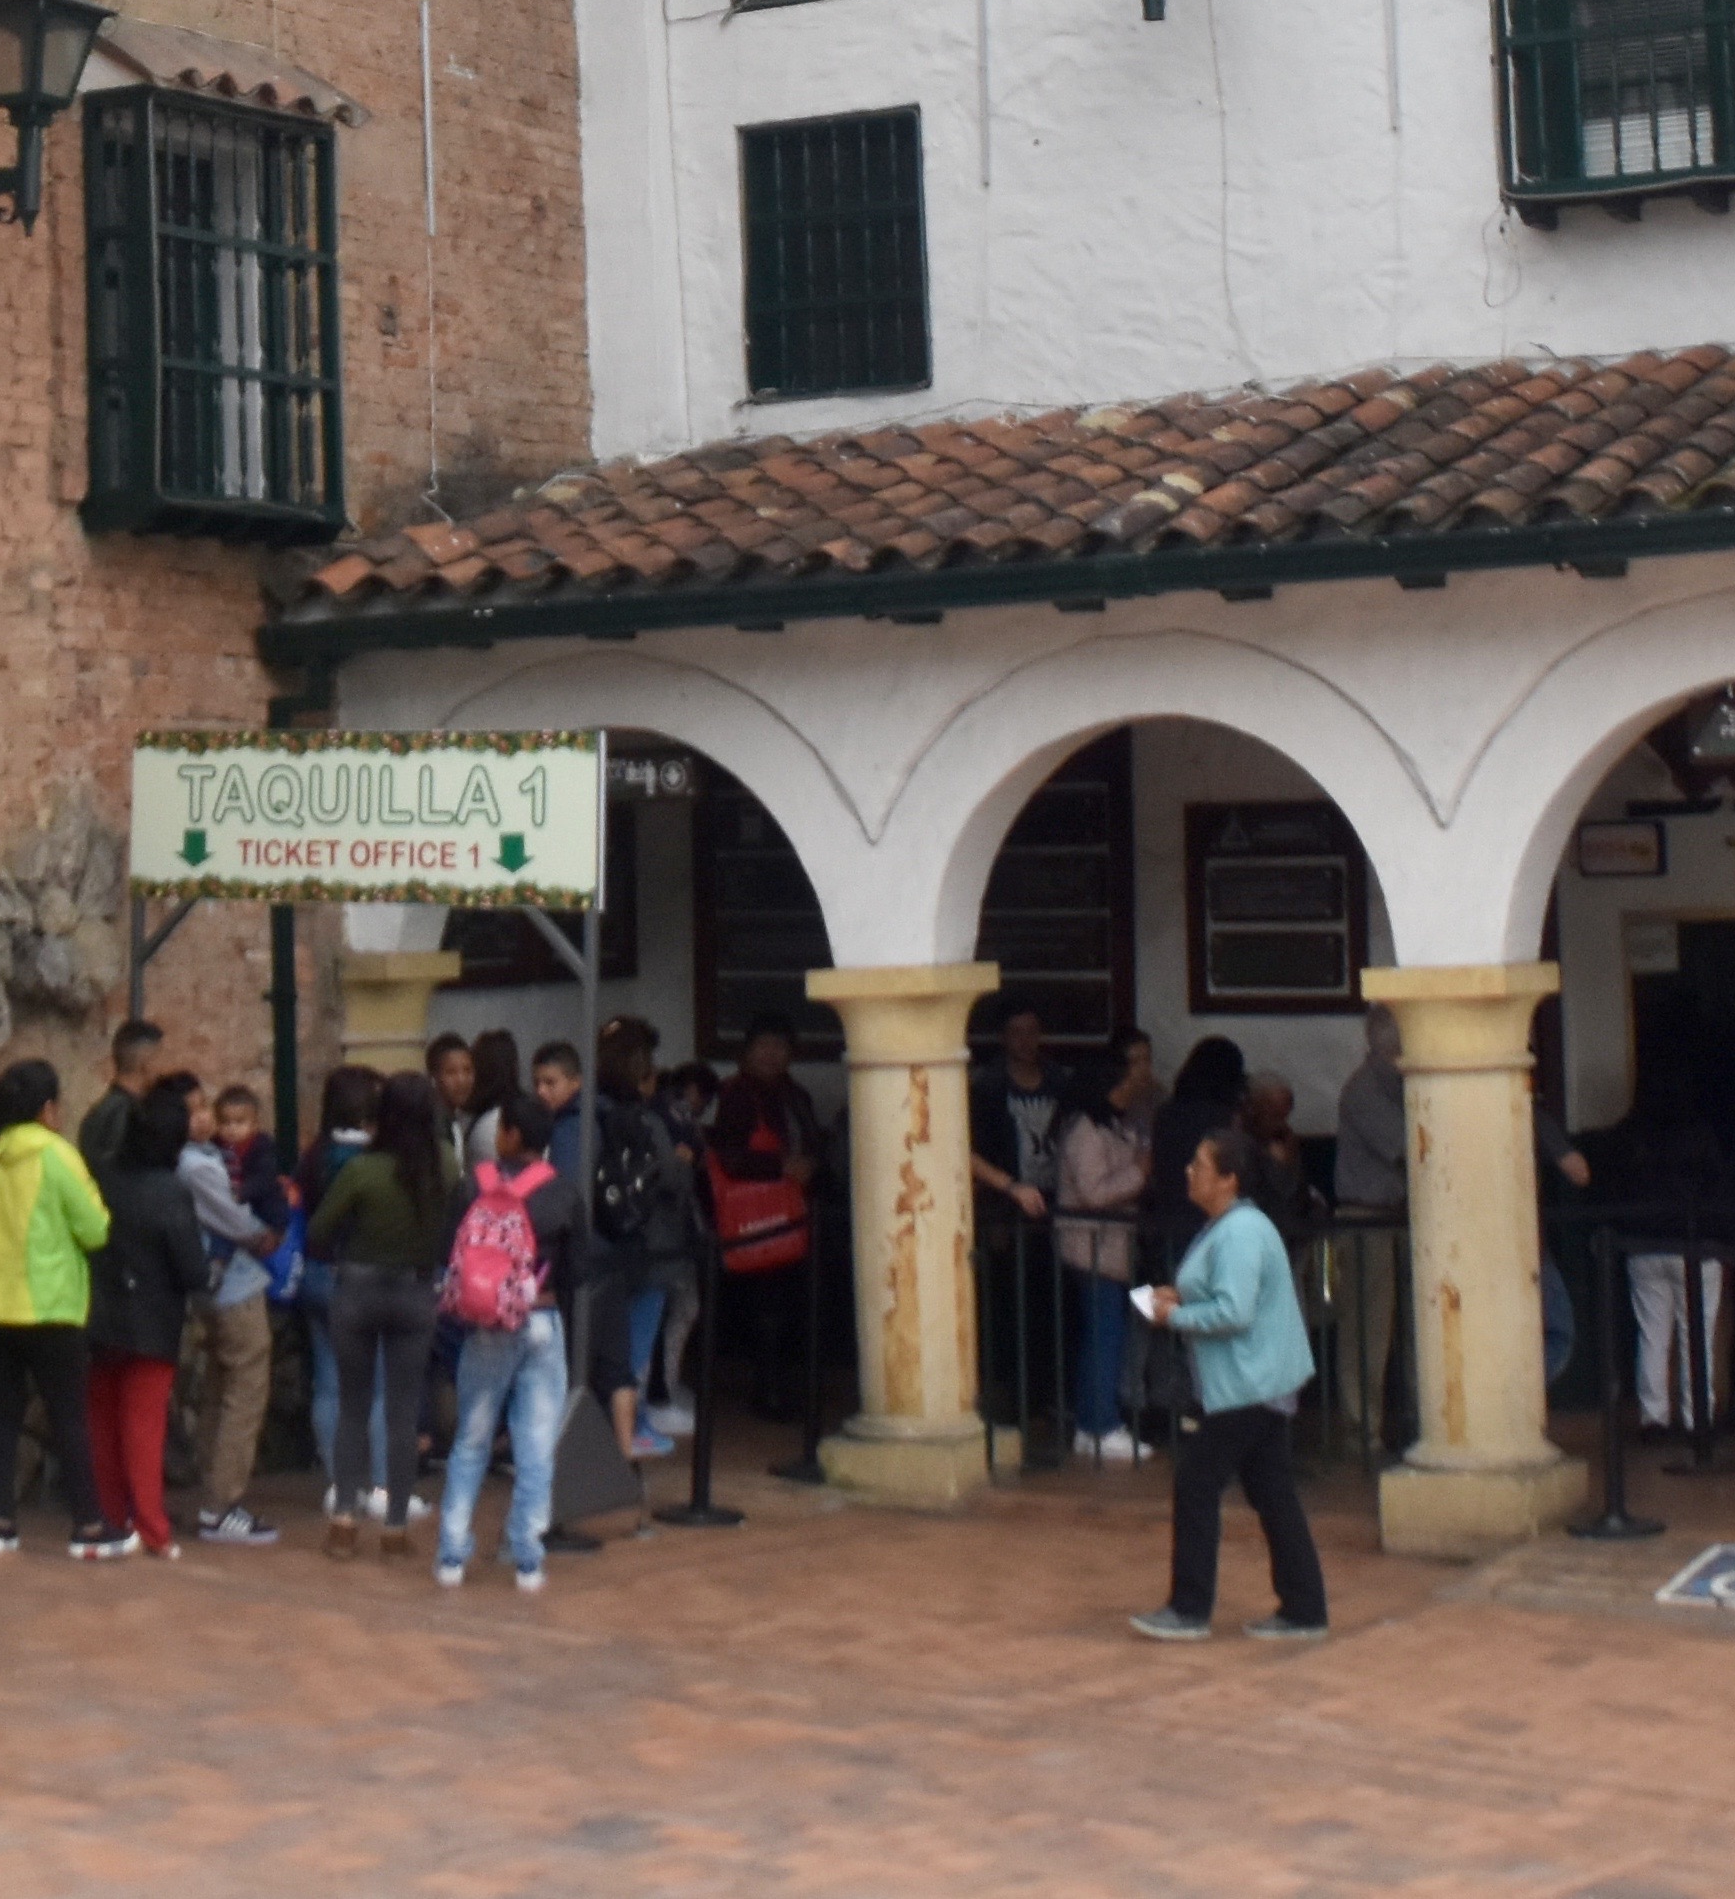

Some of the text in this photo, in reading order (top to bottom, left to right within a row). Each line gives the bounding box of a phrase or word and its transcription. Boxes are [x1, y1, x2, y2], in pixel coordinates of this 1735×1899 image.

[177, 763, 547, 828] TAQUILLA 1
[236, 838, 481, 869] TICKET OFFICE 1
